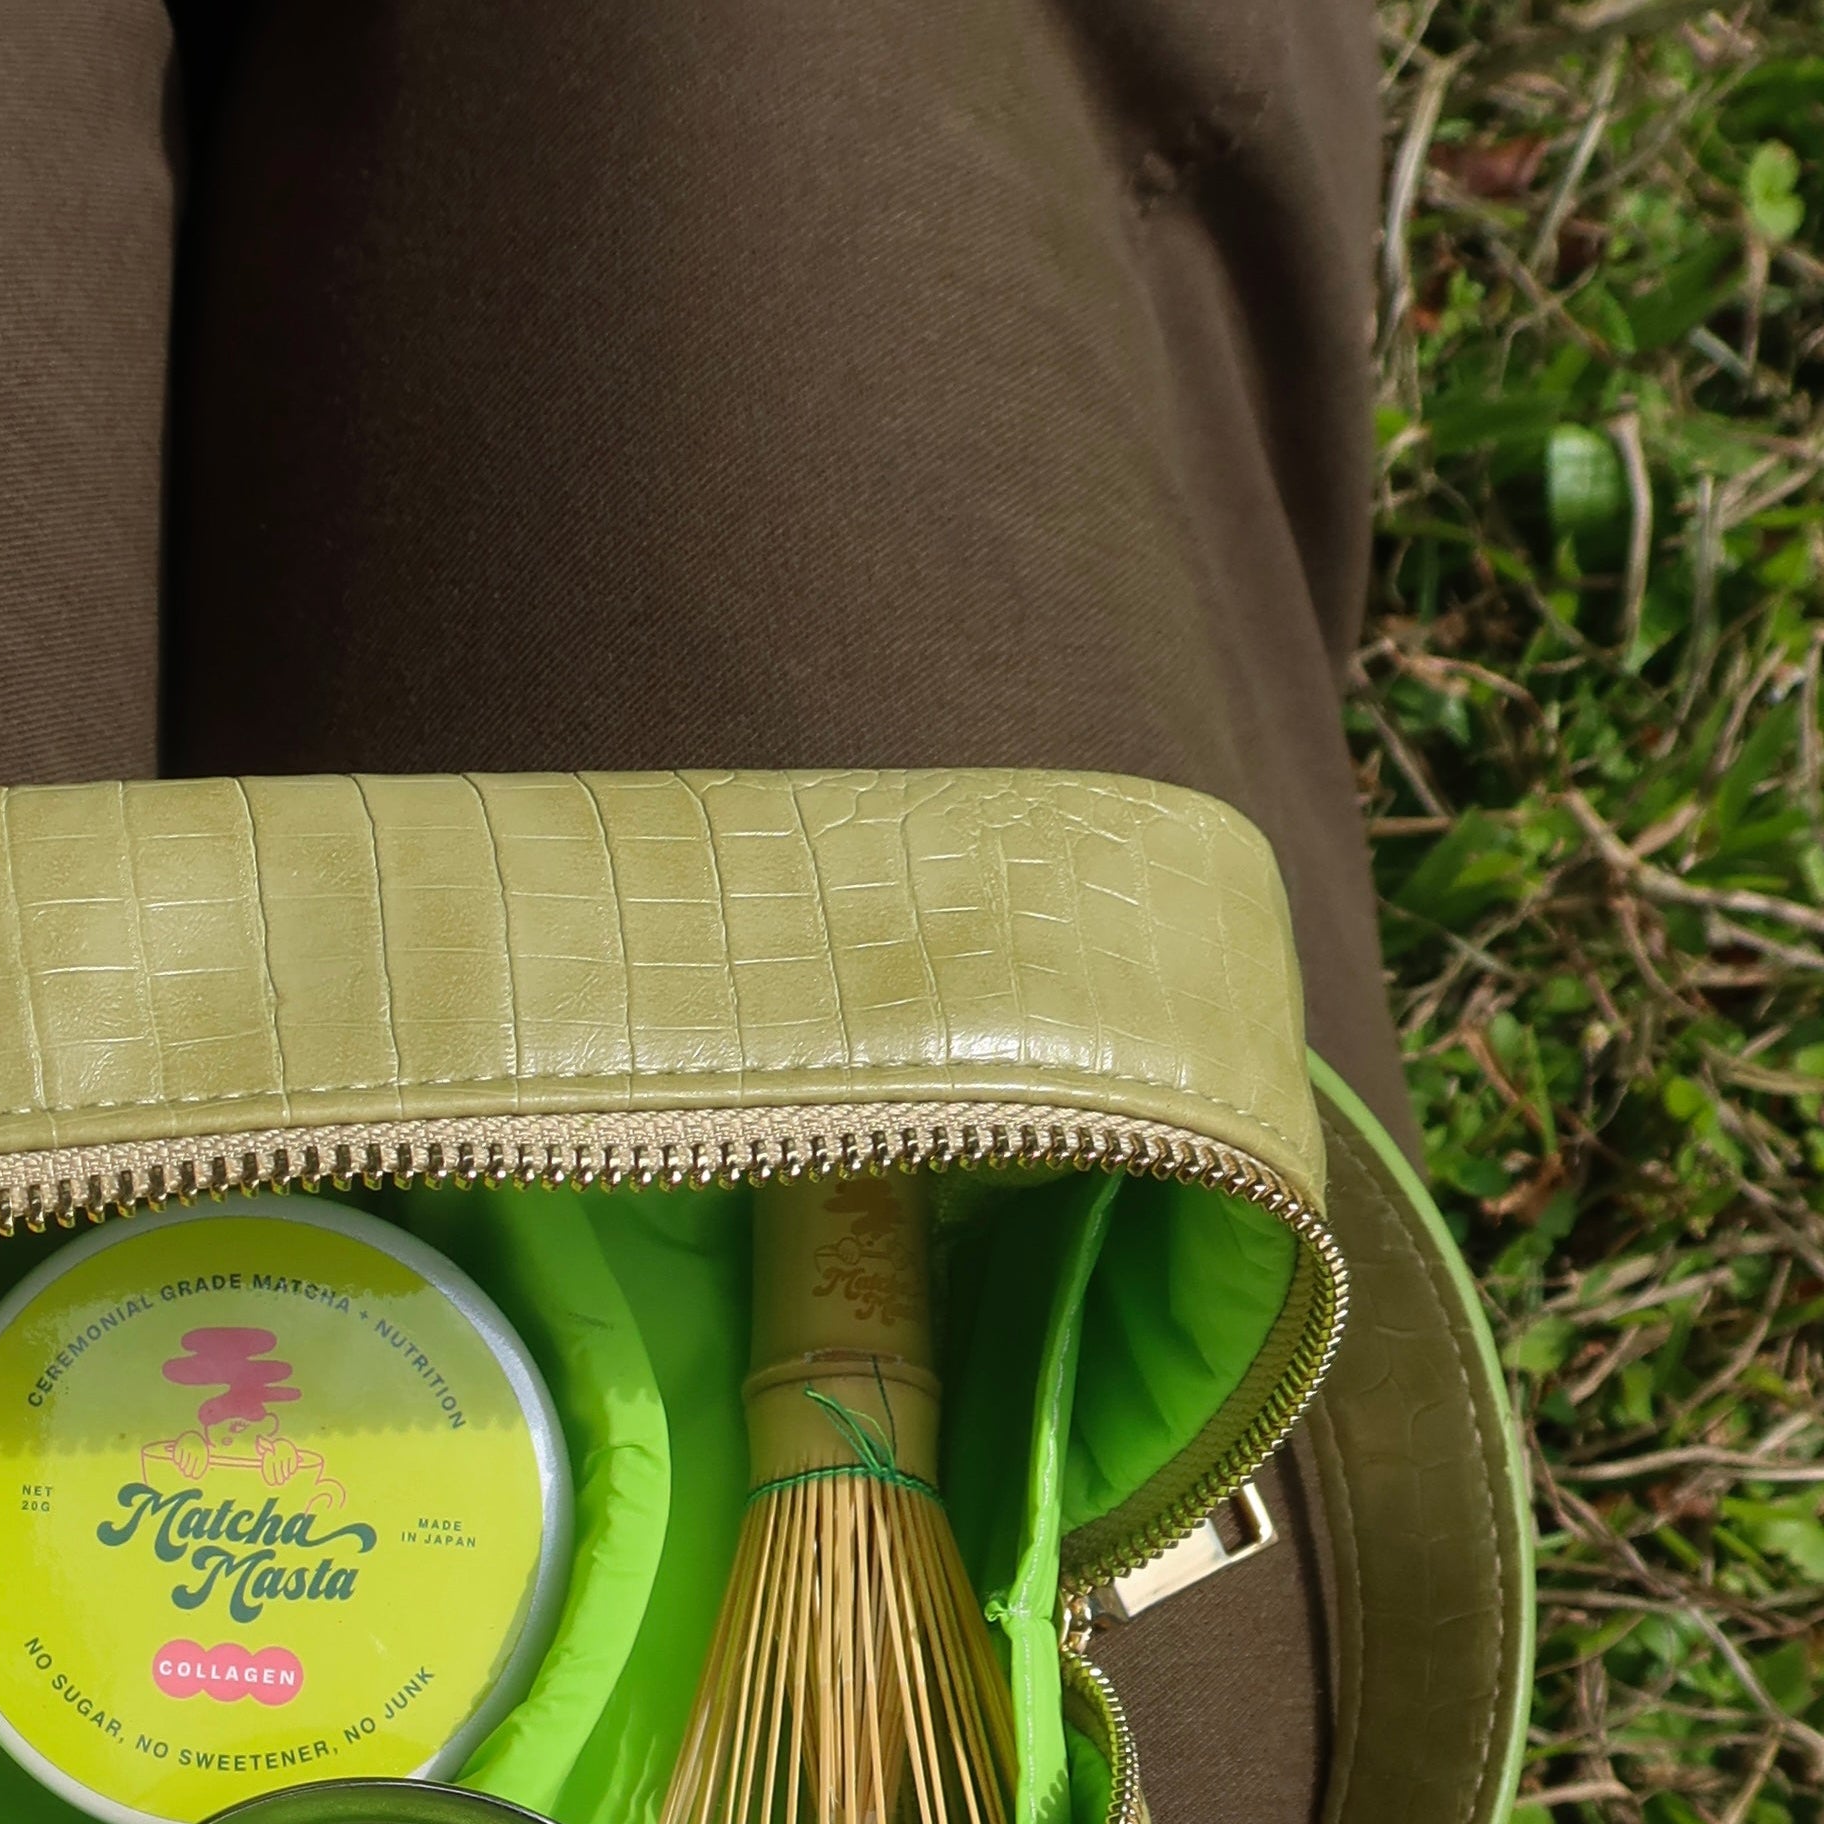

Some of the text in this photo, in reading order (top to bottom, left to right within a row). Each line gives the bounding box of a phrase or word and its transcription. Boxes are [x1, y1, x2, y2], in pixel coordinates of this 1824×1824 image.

[27, 1295, 154, 1409] CEREMONIAL
[160, 1274, 242, 1301] GRADE
[252, 1274, 351, 1315] MATCHA
[374, 1318, 467, 1429] NUTRITION
[21, 1484, 53, 1497] NET
[21, 1500, 52, 1513] 20G
[96, 1482, 377, 1562] Matcha
[418, 1518, 463, 1532] MADE
[401, 1532, 476, 1547] IN JAPAN
[171, 1545, 359, 1623] Masta
[158, 1660, 296, 1685] COLLAGEN
[24, 1637, 436, 1772] NO SUGAR, NO SWEETENER, NO JUNK
